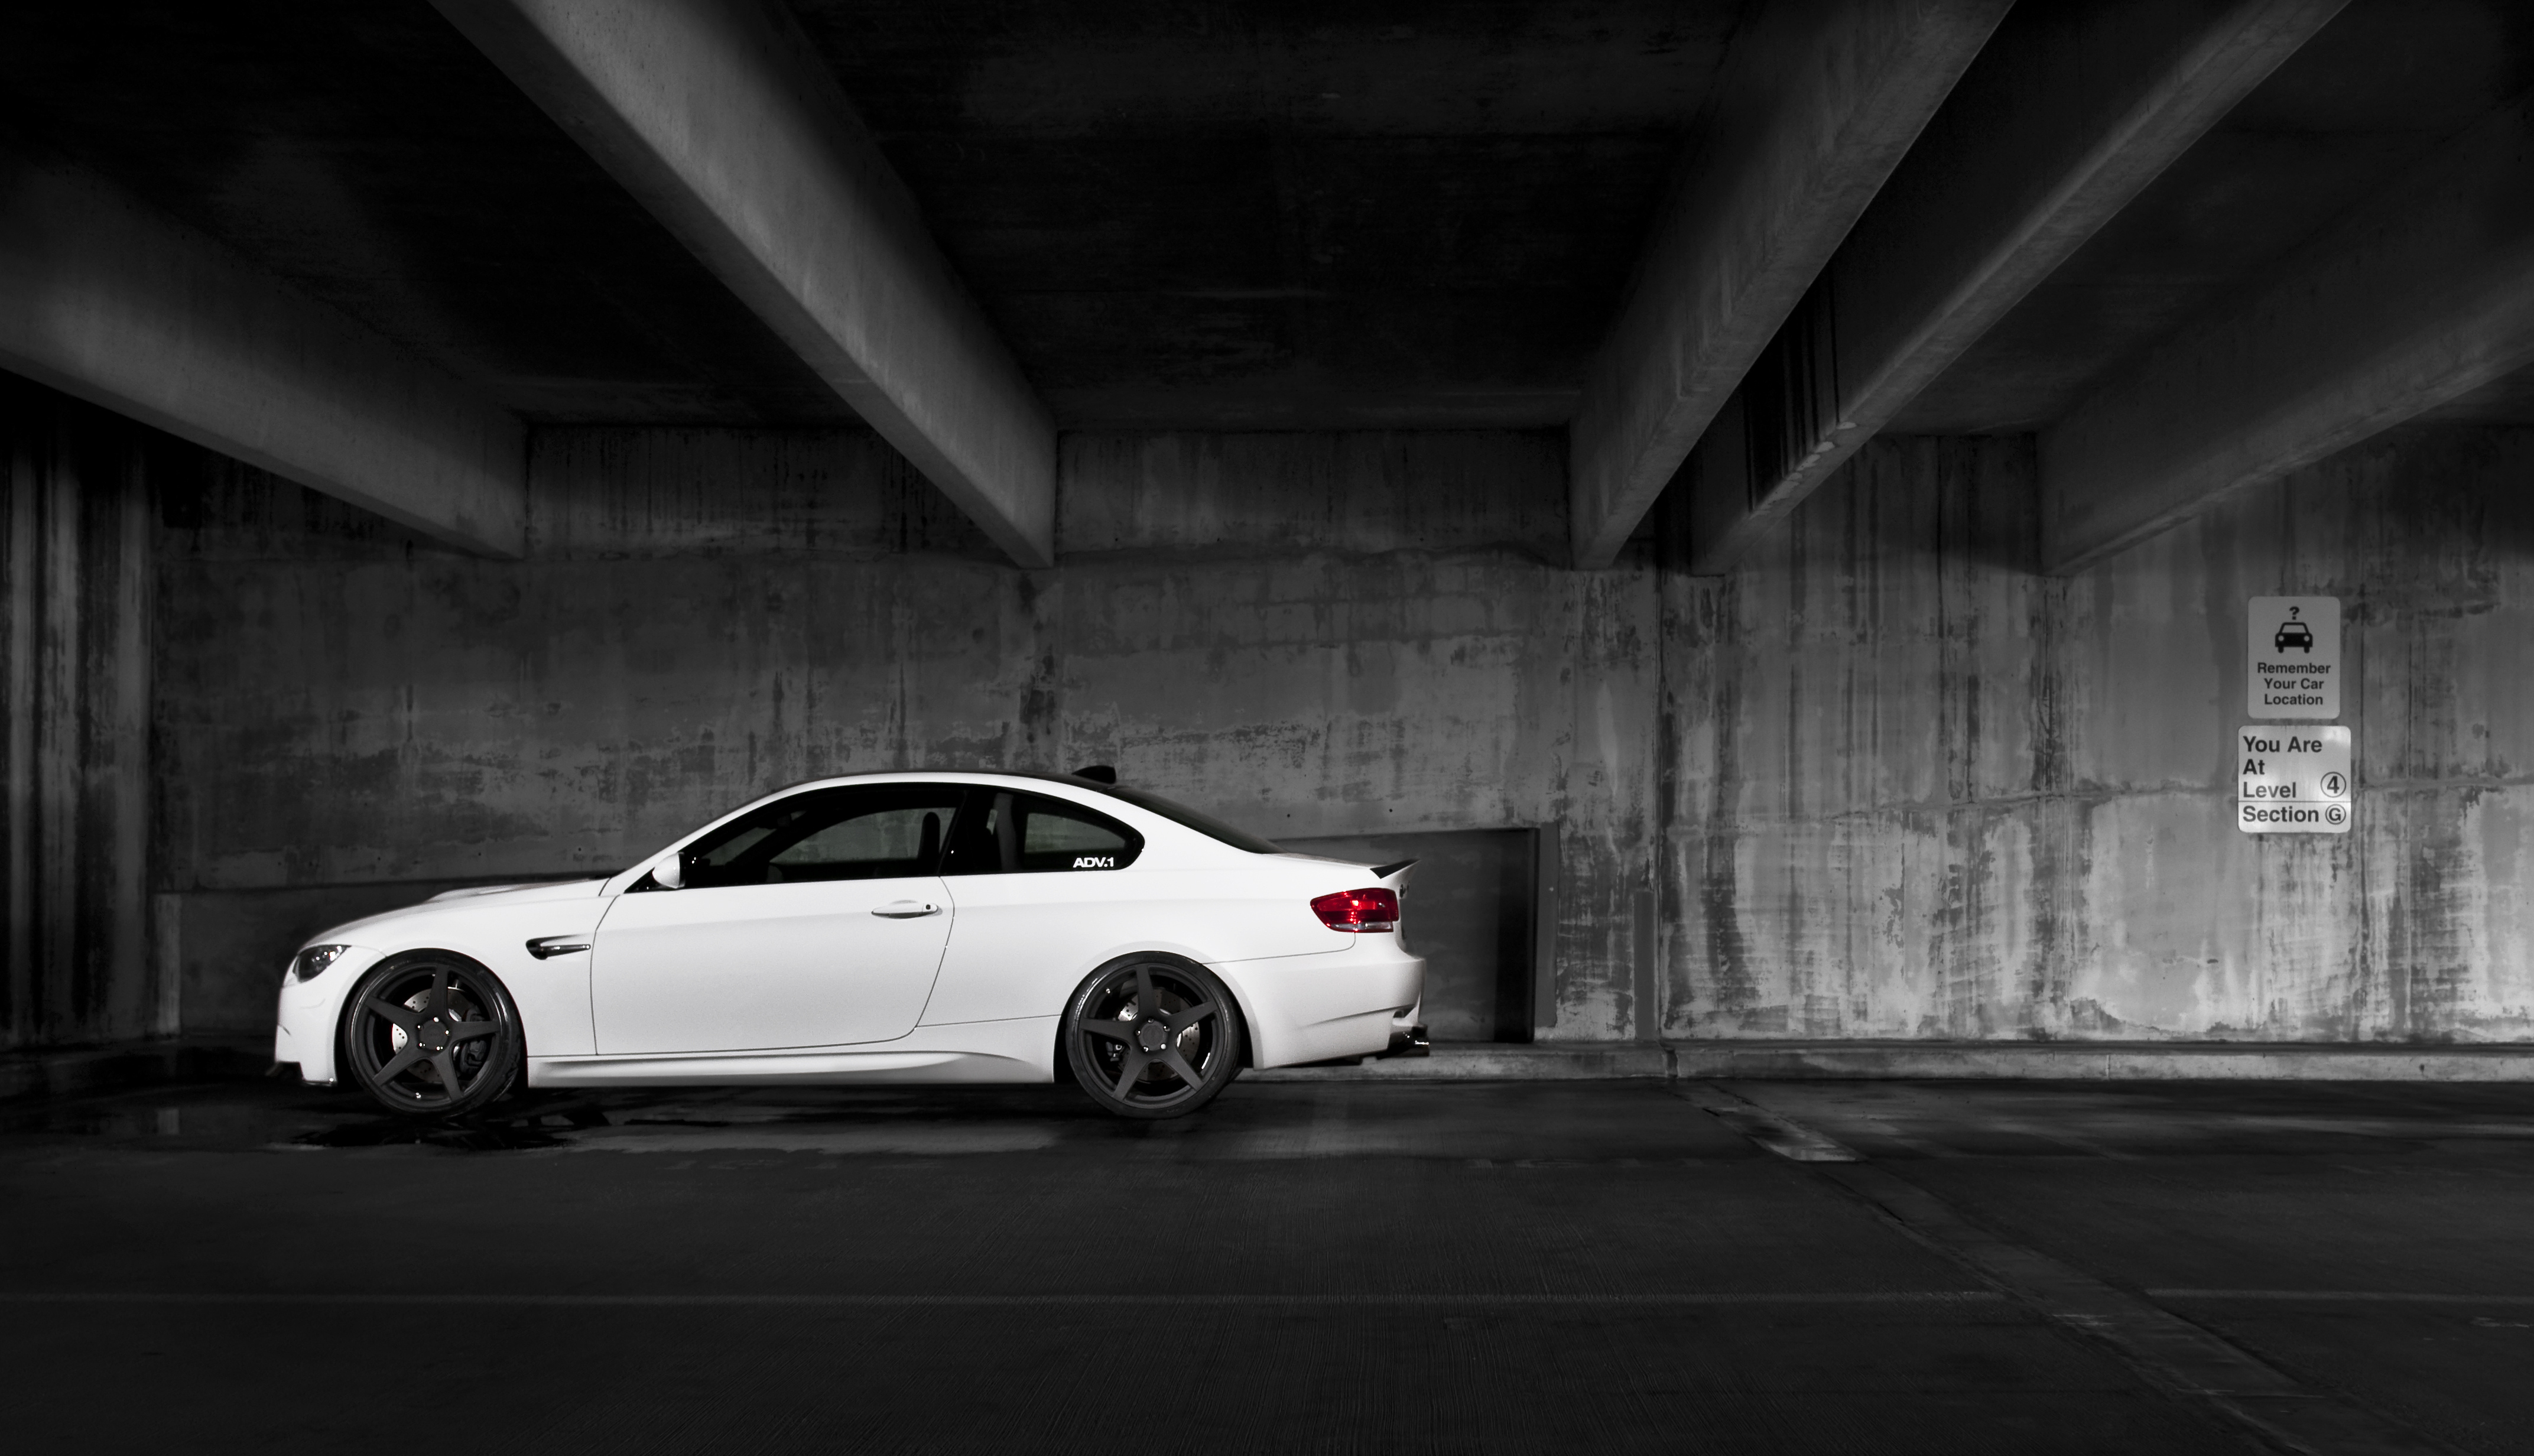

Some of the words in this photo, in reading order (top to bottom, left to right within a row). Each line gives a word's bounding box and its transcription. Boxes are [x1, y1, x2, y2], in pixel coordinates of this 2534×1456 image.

[2289, 606, 2299, 620] ?
[2257, 662, 2331, 674] Remember
[2265, 678, 2296, 689] Your
[2301, 678, 2324, 689] Car
[2265, 694, 2323, 704] Location
[2243, 736, 2279, 752] You
[2288, 736, 2322, 752] Are
[2243, 759, 2265, 774] At
[2244, 782, 2296, 798] Level
[2243, 806, 2319, 822] Section
[1073, 857, 1113, 867] ADV.1
